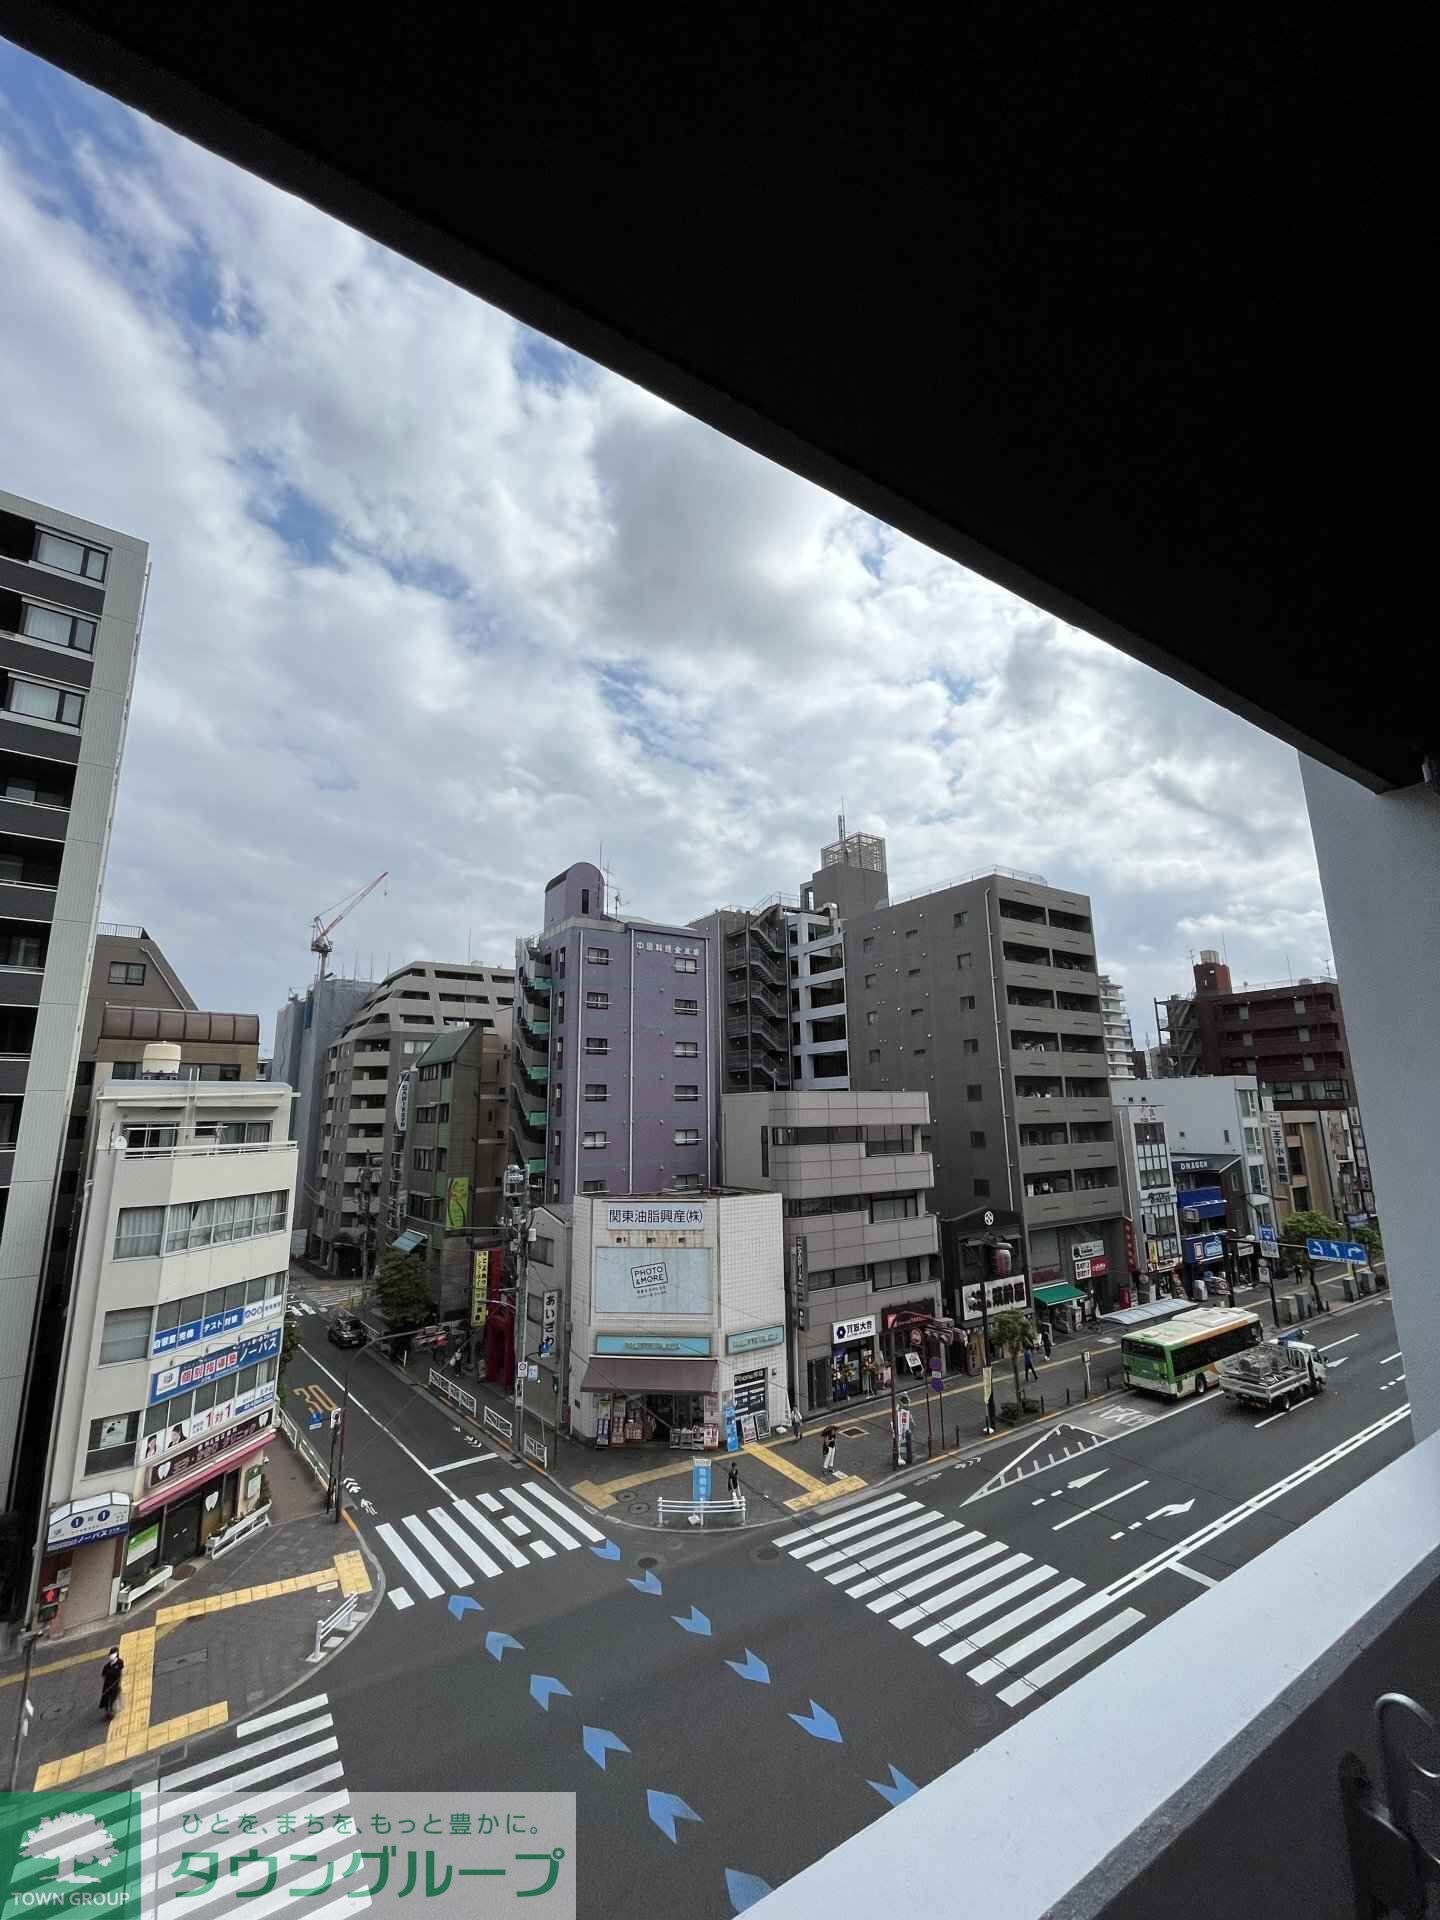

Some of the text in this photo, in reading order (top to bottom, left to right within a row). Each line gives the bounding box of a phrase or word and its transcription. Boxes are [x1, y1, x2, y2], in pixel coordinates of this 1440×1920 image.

[634, 1265, 664, 1278] PHOTO
[636, 1274, 665, 1286] &MORE
[293, 1384, 337, 1413] 30
